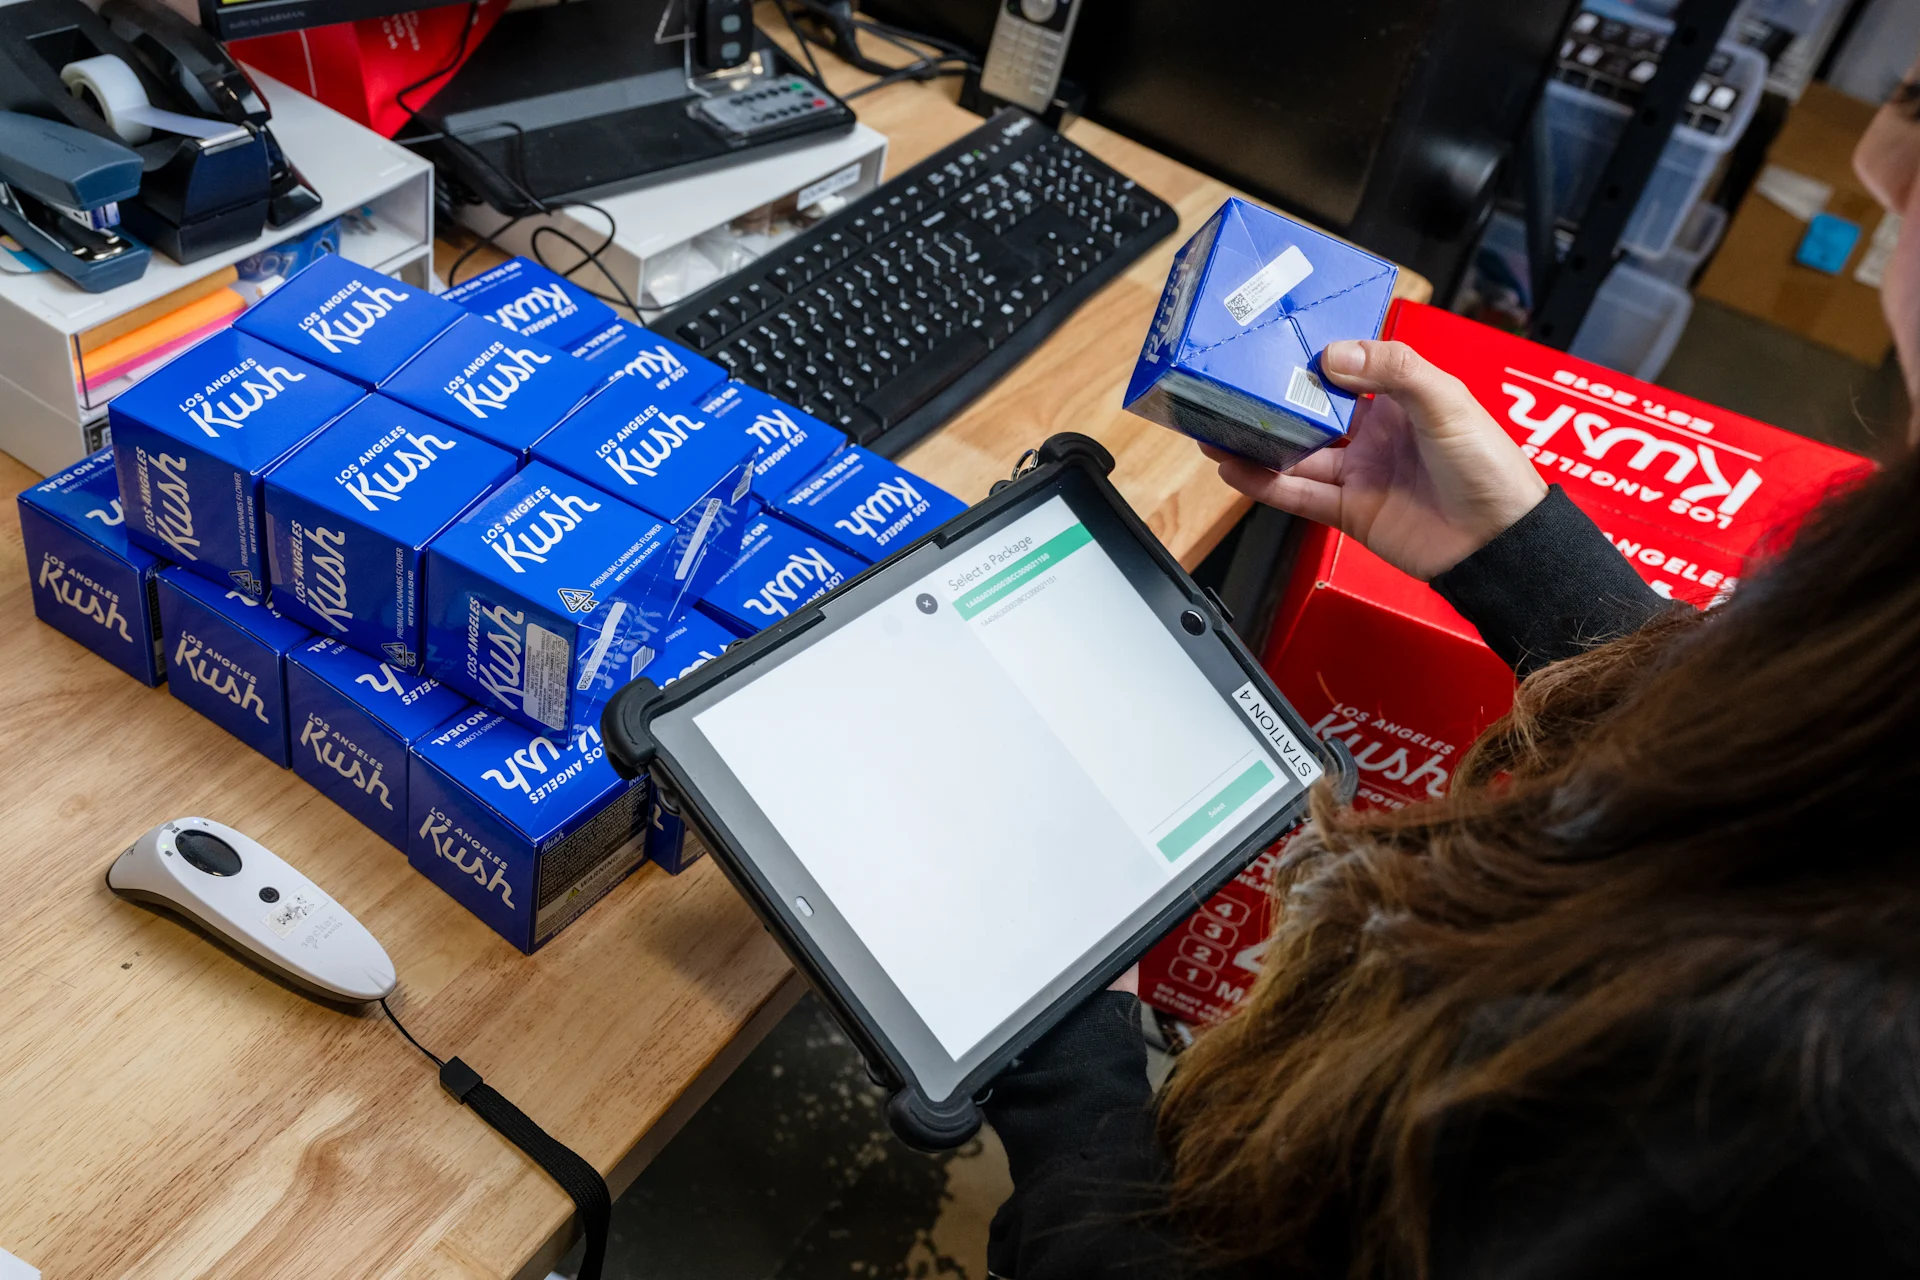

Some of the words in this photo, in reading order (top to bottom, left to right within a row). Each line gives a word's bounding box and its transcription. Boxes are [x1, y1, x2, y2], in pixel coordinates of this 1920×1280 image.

[298, 312, 321, 332] LOS
[320, 280, 362, 318] ANGELES
[308, 284, 410, 354] Kush
[559, 303, 579, 318] LOS
[179, 392, 204, 413] LOS
[205, 357, 257, 396] ANGELES
[443, 375, 466, 395] LOS
[464, 341, 505, 378] ANGELES
[453, 347, 552, 418] Kush
[669, 366, 689, 380] LOS
[188, 360, 307, 438] Kush
[1643, 400, 1715, 434] EST.
[595, 439, 618, 459] LOS
[617, 404, 659, 442] ANGELES
[745, 409, 801, 446] Ku
[790, 430, 808, 446] LOS
[335, 465, 360, 486] LOS
[358, 425, 407, 468] ANGELES
[605, 411, 706, 485] Kush
[754, 443, 791, 476] ANGELES
[1501, 382, 1763, 516] Kush
[37, 471, 75, 493] DEAL
[73, 461, 96, 476] NO
[136, 446, 152, 508] ANGELES
[233, 472, 243, 502] FLOWER
[345, 432, 457, 512] Kush
[1520, 444, 1664, 503] ANGELES
[143, 506, 157, 534] LOS
[147, 452, 201, 561] Kush
[236, 500, 246, 537] CANNABIS
[481, 523, 505, 545] LOS
[504, 485, 551, 527] ANGELES
[834, 476, 922, 538] Kush
[911, 499, 931, 517] LOS
[1668, 498, 1734, 530] LOS
[491, 492, 601, 573] Kush
[751, 522, 768, 537] NO
[876, 510, 914, 546] ANGELES
[240, 535, 250, 568] PREMIUM
[291, 519, 306, 580] ANGELES
[395, 547, 404, 576] FLOWER
[590, 564, 617, 590] PREMIUM
[615, 541, 643, 568] CANNABIS
[640, 523, 664, 546] FLOWER
[948, 565, 984, 592] Select
[982, 560, 992, 572] a
[989, 535, 1034, 566] Package
[43, 552, 66, 570] LOS
[67, 567, 120, 603] ANGELES
[295, 579, 307, 605] LOS
[304, 526, 354, 632] Kush
[396, 575, 404, 609] CANNABIS
[743, 547, 835, 617] Kush
[825, 571, 845, 589] LOS
[38, 561, 134, 643] Kush
[581, 599, 599, 613] CA
[396, 608, 405, 640] PREMIUM
[467, 597, 482, 656] ANGELES
[181, 630, 204, 650] LOS
[205, 644, 258, 684] ANGELES
[307, 636, 338, 653] EAL
[331, 645, 349, 656] WER
[478, 605, 526, 711] Kush
[174, 638, 270, 724] Kush
[466, 653, 478, 681] LOS
[402, 679, 440, 706] GELES
[1239, 689, 1252, 701] 4
[431, 725, 469, 746] DEAL
[455, 726, 484, 749] FLOWER
[467, 710, 488, 726] NO
[479, 715, 506, 734] NNABIS
[1332, 702, 1371, 723] LOS
[1371, 718, 1456, 756] ANGELES
[308, 712, 330, 732] LOS
[332, 731, 385, 771] ANGELES
[1249, 702, 1313, 778] STATION
[1312, 712, 1449, 799] Kush
[300, 720, 394, 811] Kush
[529, 760, 585, 804] ANGELES
[1207, 802, 1226, 818] Select
[430, 807, 453, 828] LOS
[454, 826, 509, 869] ANGELES
[418, 814, 515, 910] Kush
[1214, 902, 1234, 918] 4
[1203, 924, 1223, 940] 3
[1193, 945, 1212, 962] 2
[1186, 967, 1199, 982] 1
